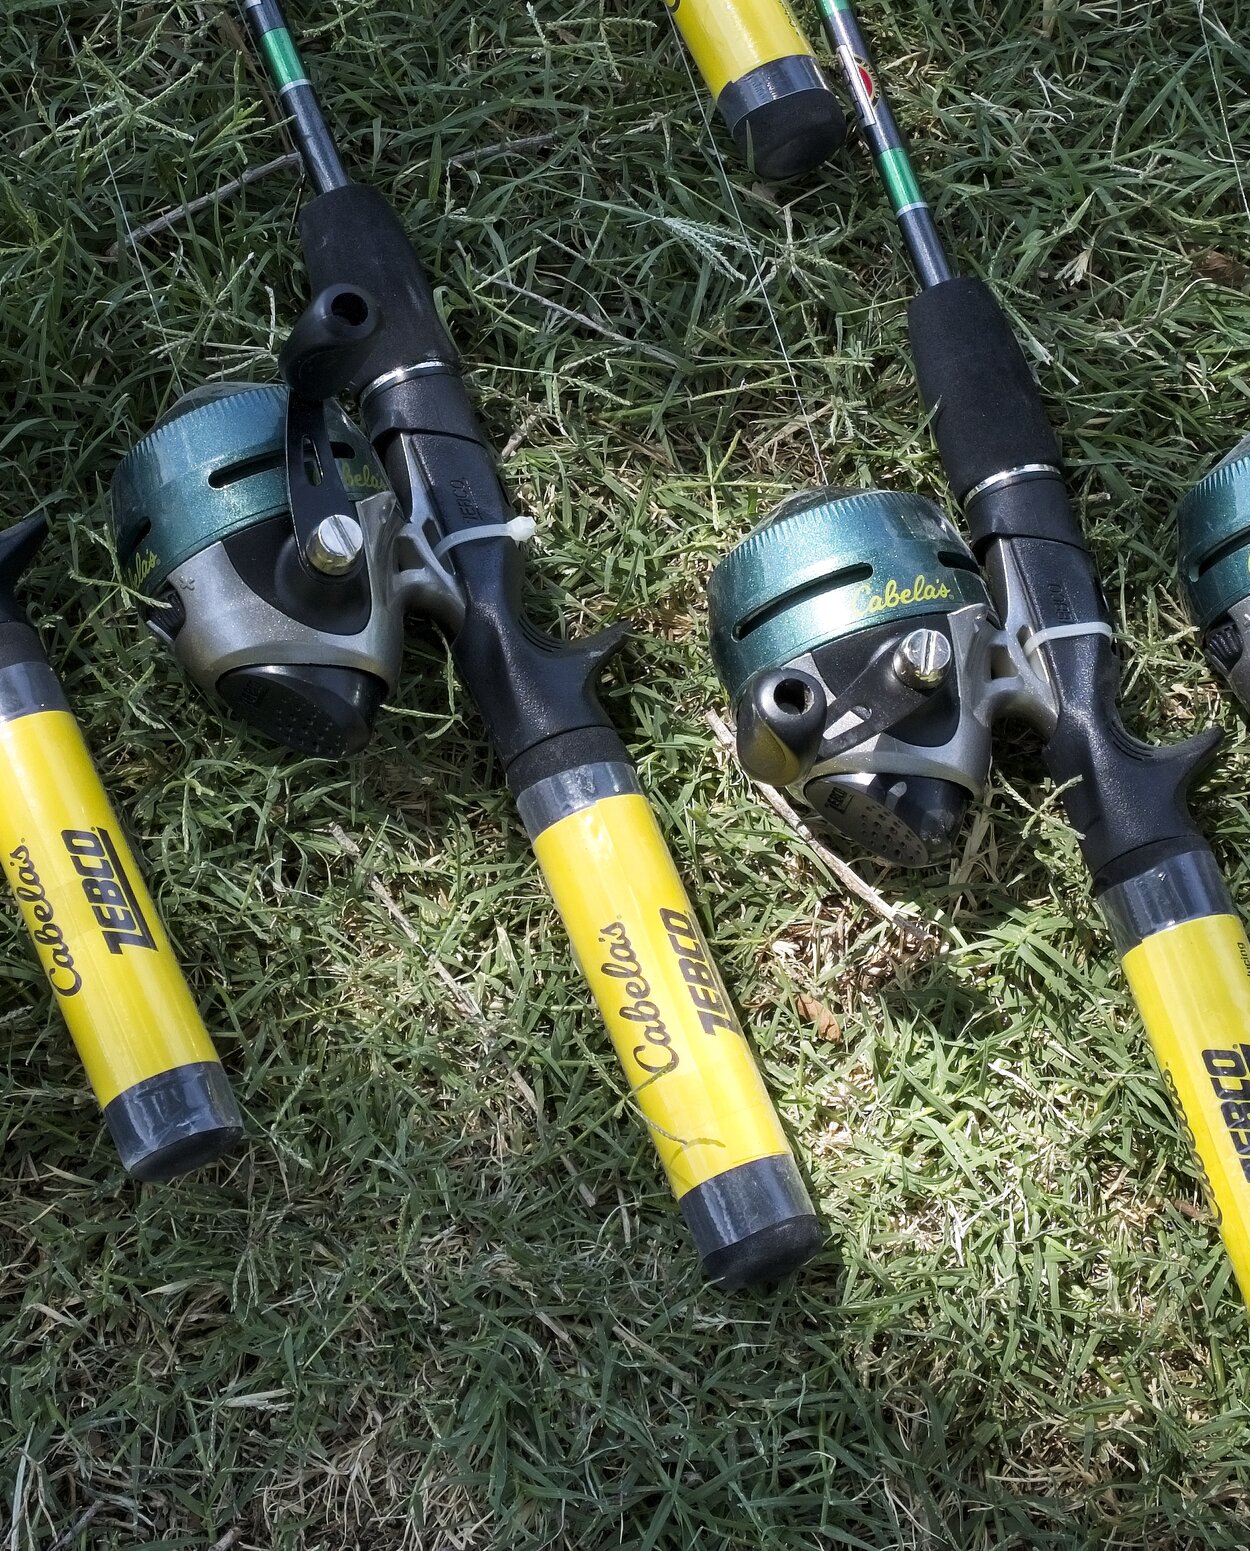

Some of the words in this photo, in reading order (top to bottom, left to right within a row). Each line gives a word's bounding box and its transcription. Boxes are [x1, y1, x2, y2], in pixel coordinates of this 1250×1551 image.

[851, 575, 951, 614] Cabela's
[10, 845, 82, 996] Cabela's
[61, 827, 158, 955] ZEBCO
[598, 922, 680, 1074] Cabela's
[659, 908, 743, 1038] ZEBCO
